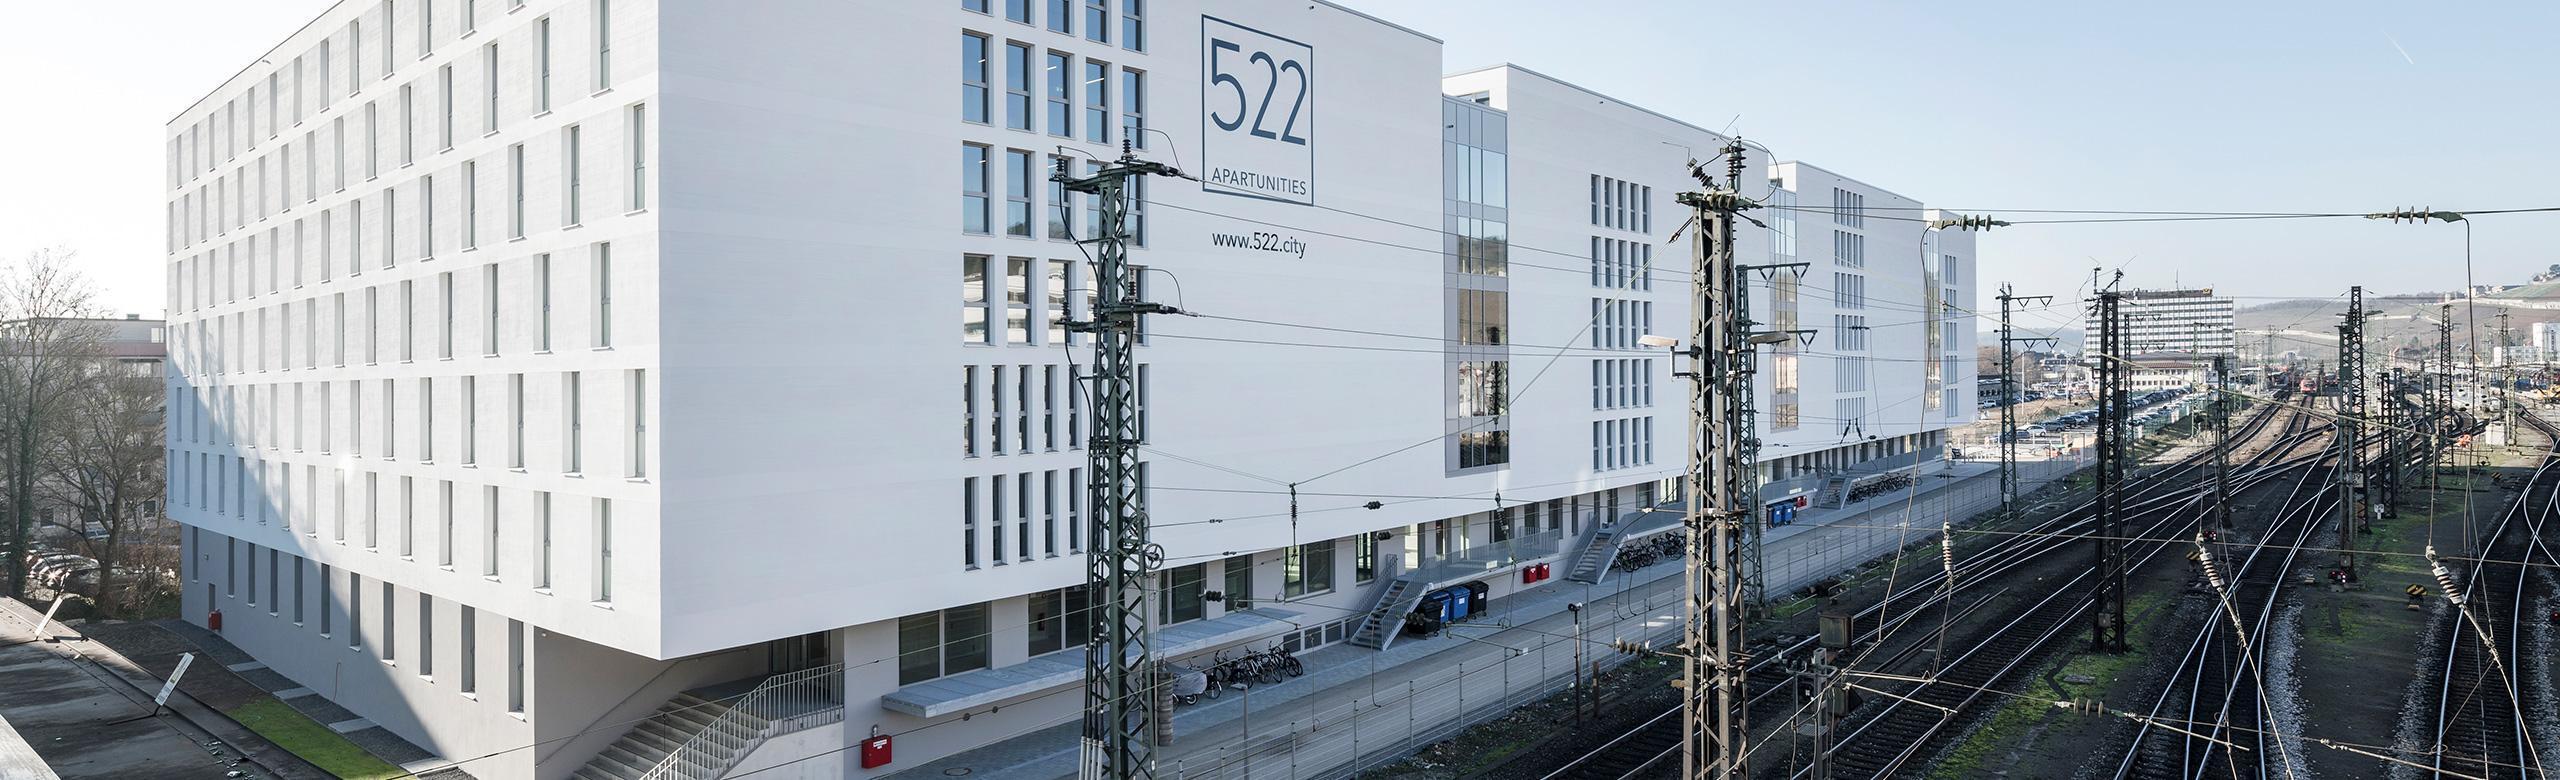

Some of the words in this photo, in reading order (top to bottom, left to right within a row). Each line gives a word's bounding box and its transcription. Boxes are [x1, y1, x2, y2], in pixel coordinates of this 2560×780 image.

[1211, 37, 1307, 146] 522
[1211, 167, 1307, 196] APARTUNITIES
[1212, 231, 1306, 259] www.522.city
